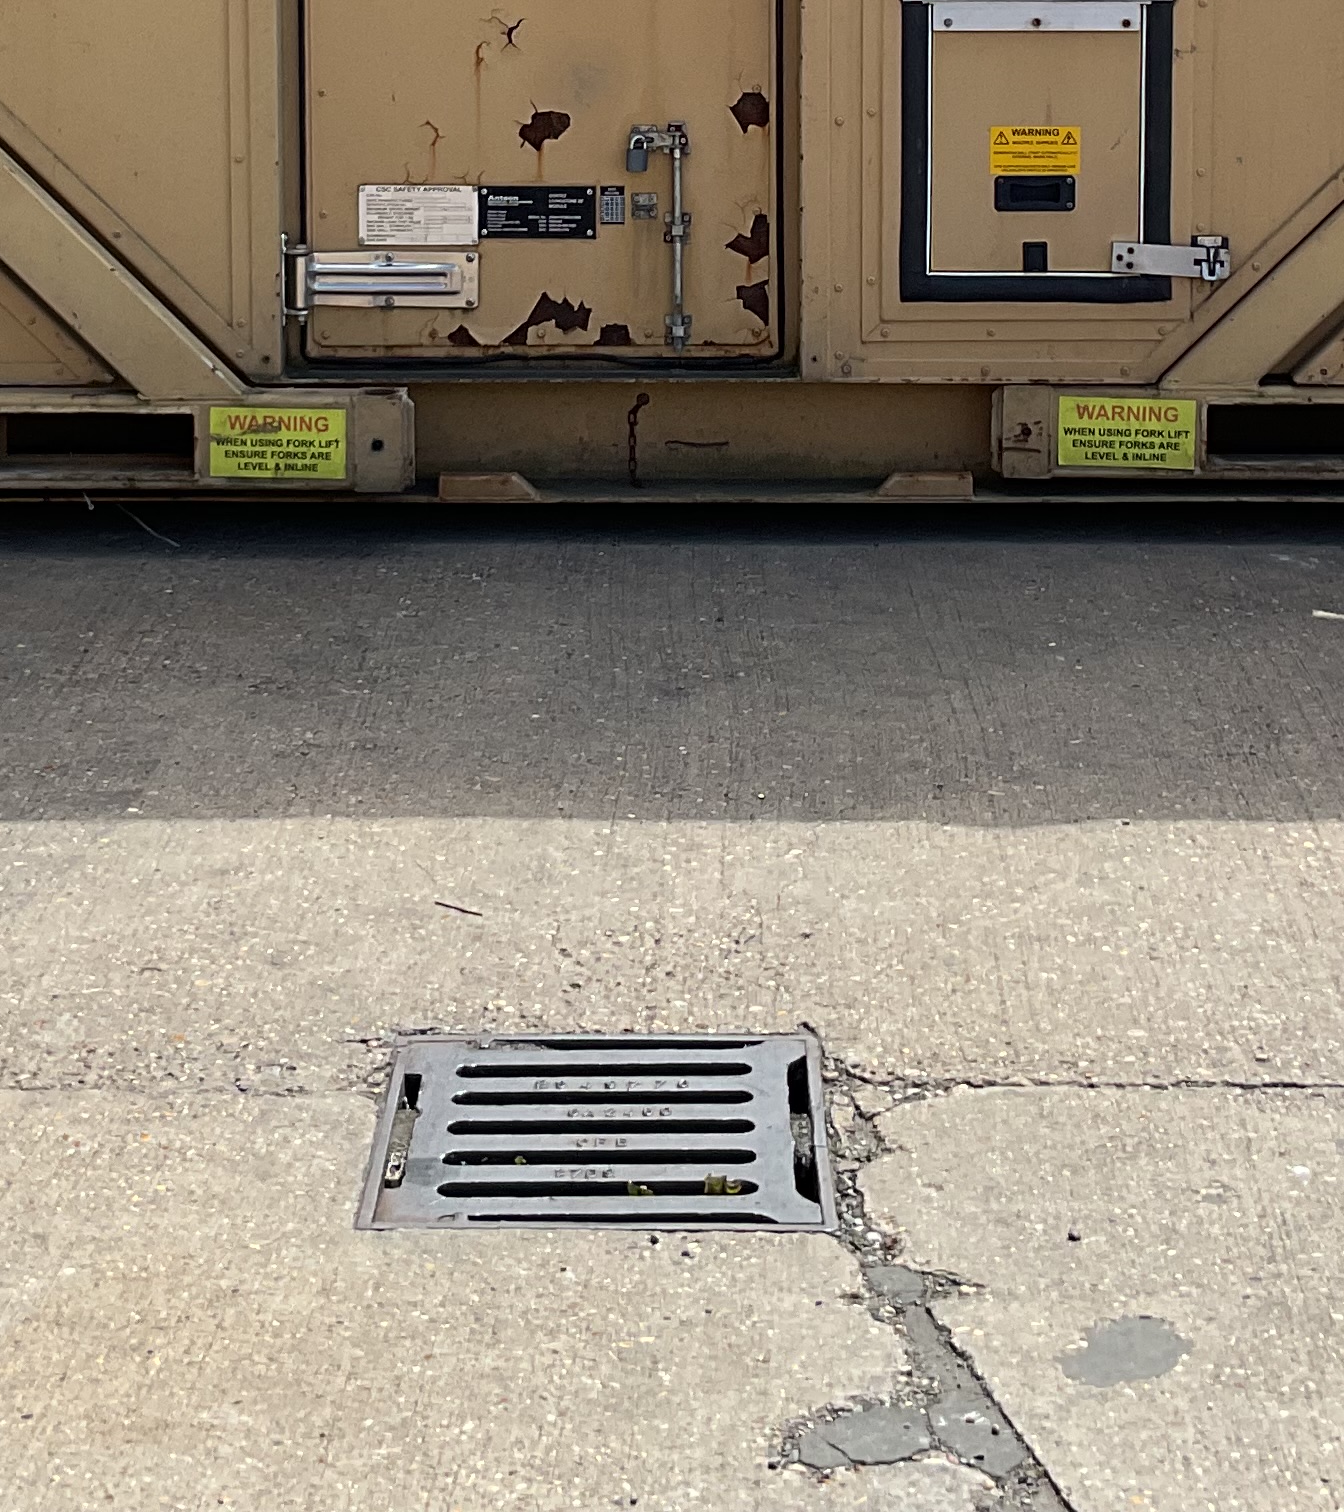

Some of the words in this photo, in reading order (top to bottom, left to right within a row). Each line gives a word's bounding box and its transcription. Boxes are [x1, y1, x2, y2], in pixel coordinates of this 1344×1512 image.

[1011, 128, 1060, 137] WARNING
[1076, 404, 1179, 423] WARNING
[227, 414, 329, 433] WARNING
[1063, 427, 1096, 437] WHEN
[1098, 428, 1132, 438] USING
[1135, 429, 1165, 439] FORK
[1167, 430, 1190, 440] LIFT
[216, 437, 247, 447] WHEN
[250, 438, 283, 448] USING
[286, 439, 316, 448] FORK
[318, 438, 340, 449] LIFT
[1072, 439, 1116, 449] ENSURE
[1118, 440, 1156, 450] FORKS
[1158, 441, 1180, 451] ARE
[224, 450, 268, 459] ENSURE
[271, 451, 307, 460] FORKS
[310, 452, 332, 461] ARE
[1084, 451, 1120, 461] LEVEL
[1122, 452, 1129, 461] &
[1132, 453, 1167, 462] INLINE
[237, 462, 272, 471] LEVEL
[284, 463, 319, 473] INLINE
